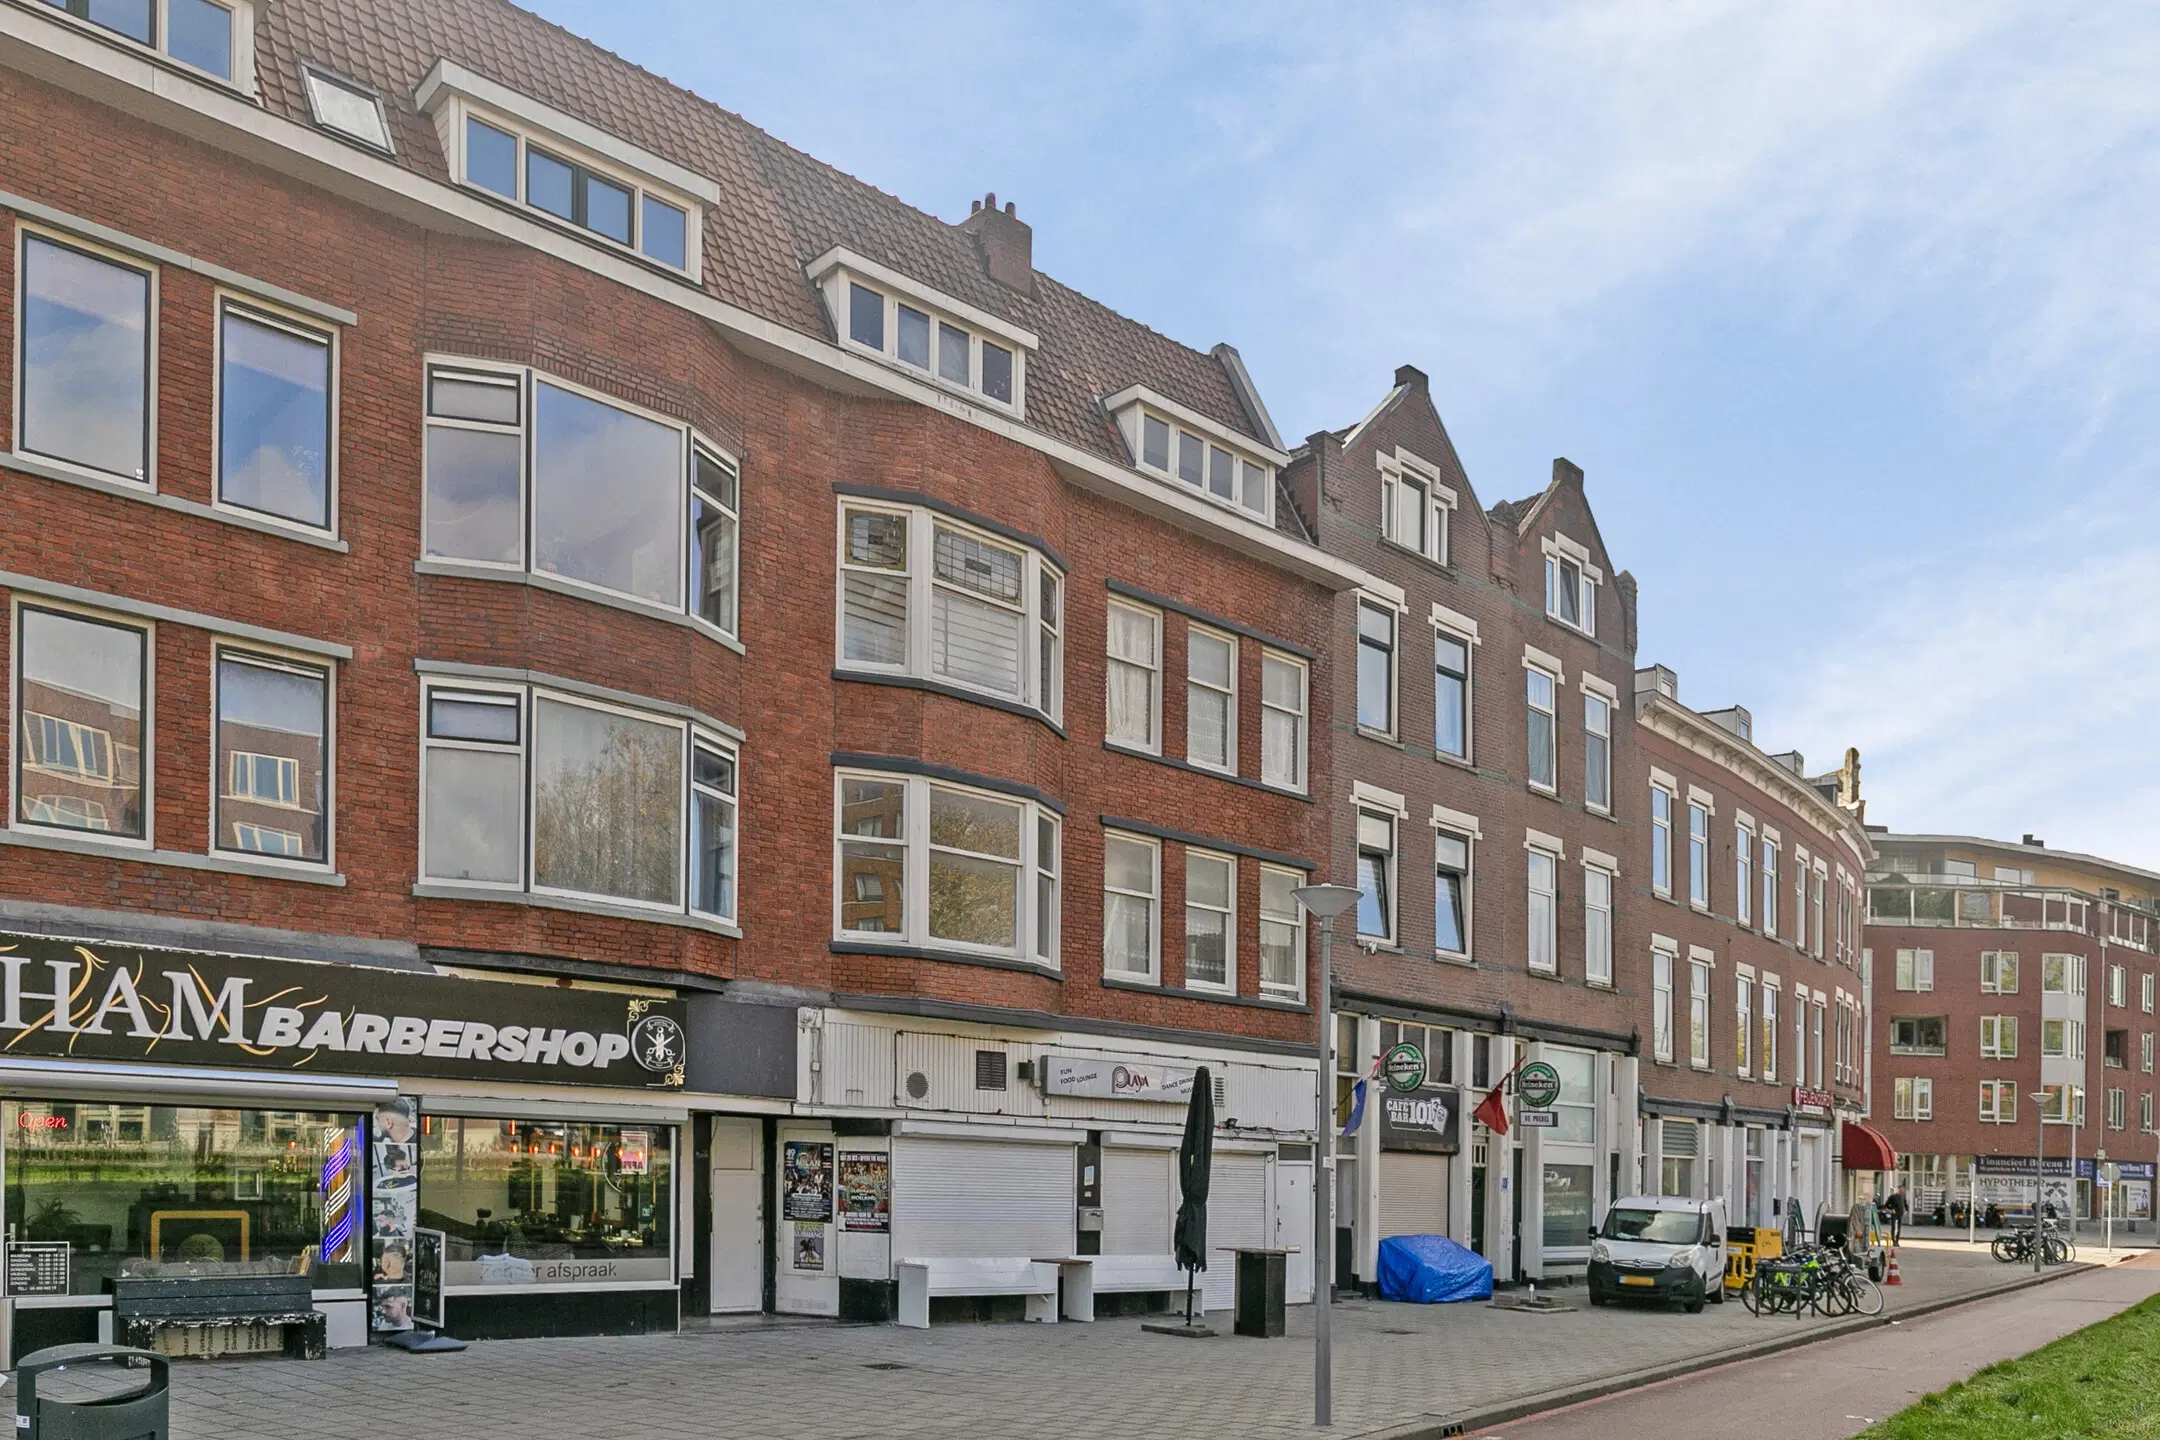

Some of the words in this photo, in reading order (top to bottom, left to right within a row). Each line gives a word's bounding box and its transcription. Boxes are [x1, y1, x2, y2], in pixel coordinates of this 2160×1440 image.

[257, 1005, 630, 1069] BARBERSHOP
[1060, 1076, 1075, 1085] FOOD
[1077, 1073, 1097, 1083] LOUNGE
[1162, 1082, 1178, 1091] DANCE
[17, 1112, 68, 1132] Open
[1391, 1112, 1409, 1123] BAR
[2029, 1158, 2062, 1168] Breau
[547, 1262, 617, 1281] afspraak
